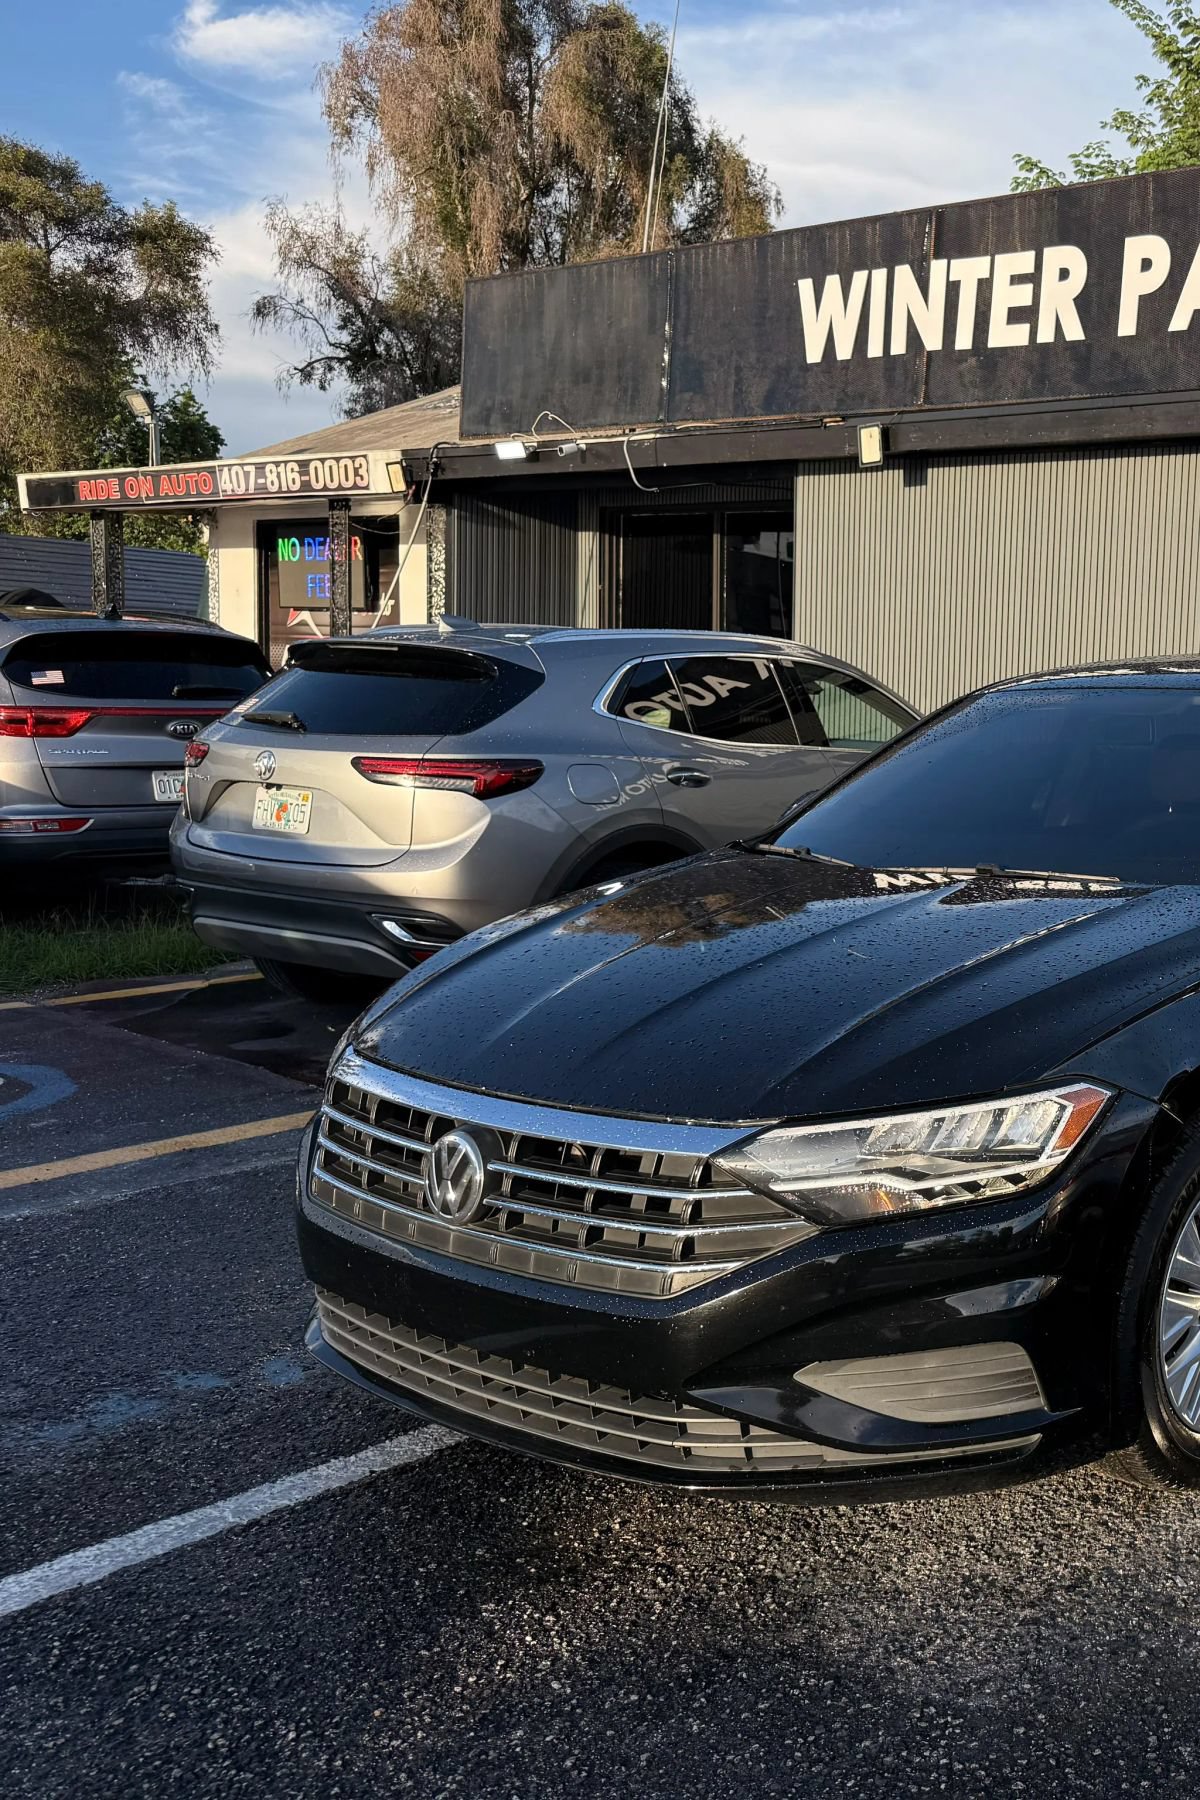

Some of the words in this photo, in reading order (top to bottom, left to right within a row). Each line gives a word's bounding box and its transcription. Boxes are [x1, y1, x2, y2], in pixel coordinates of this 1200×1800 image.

[798, 244, 1087, 364] WINTER
[79, 479, 120, 500] RIDE
[125, 475, 155, 498] ON
[159, 472, 213, 496] AUTO
[220, 459, 370, 494] 407-816-0003
[278, 537, 300, 562] NO
[304, 536, 364, 561] DEAR
[176, 726, 196, 734] KIA
